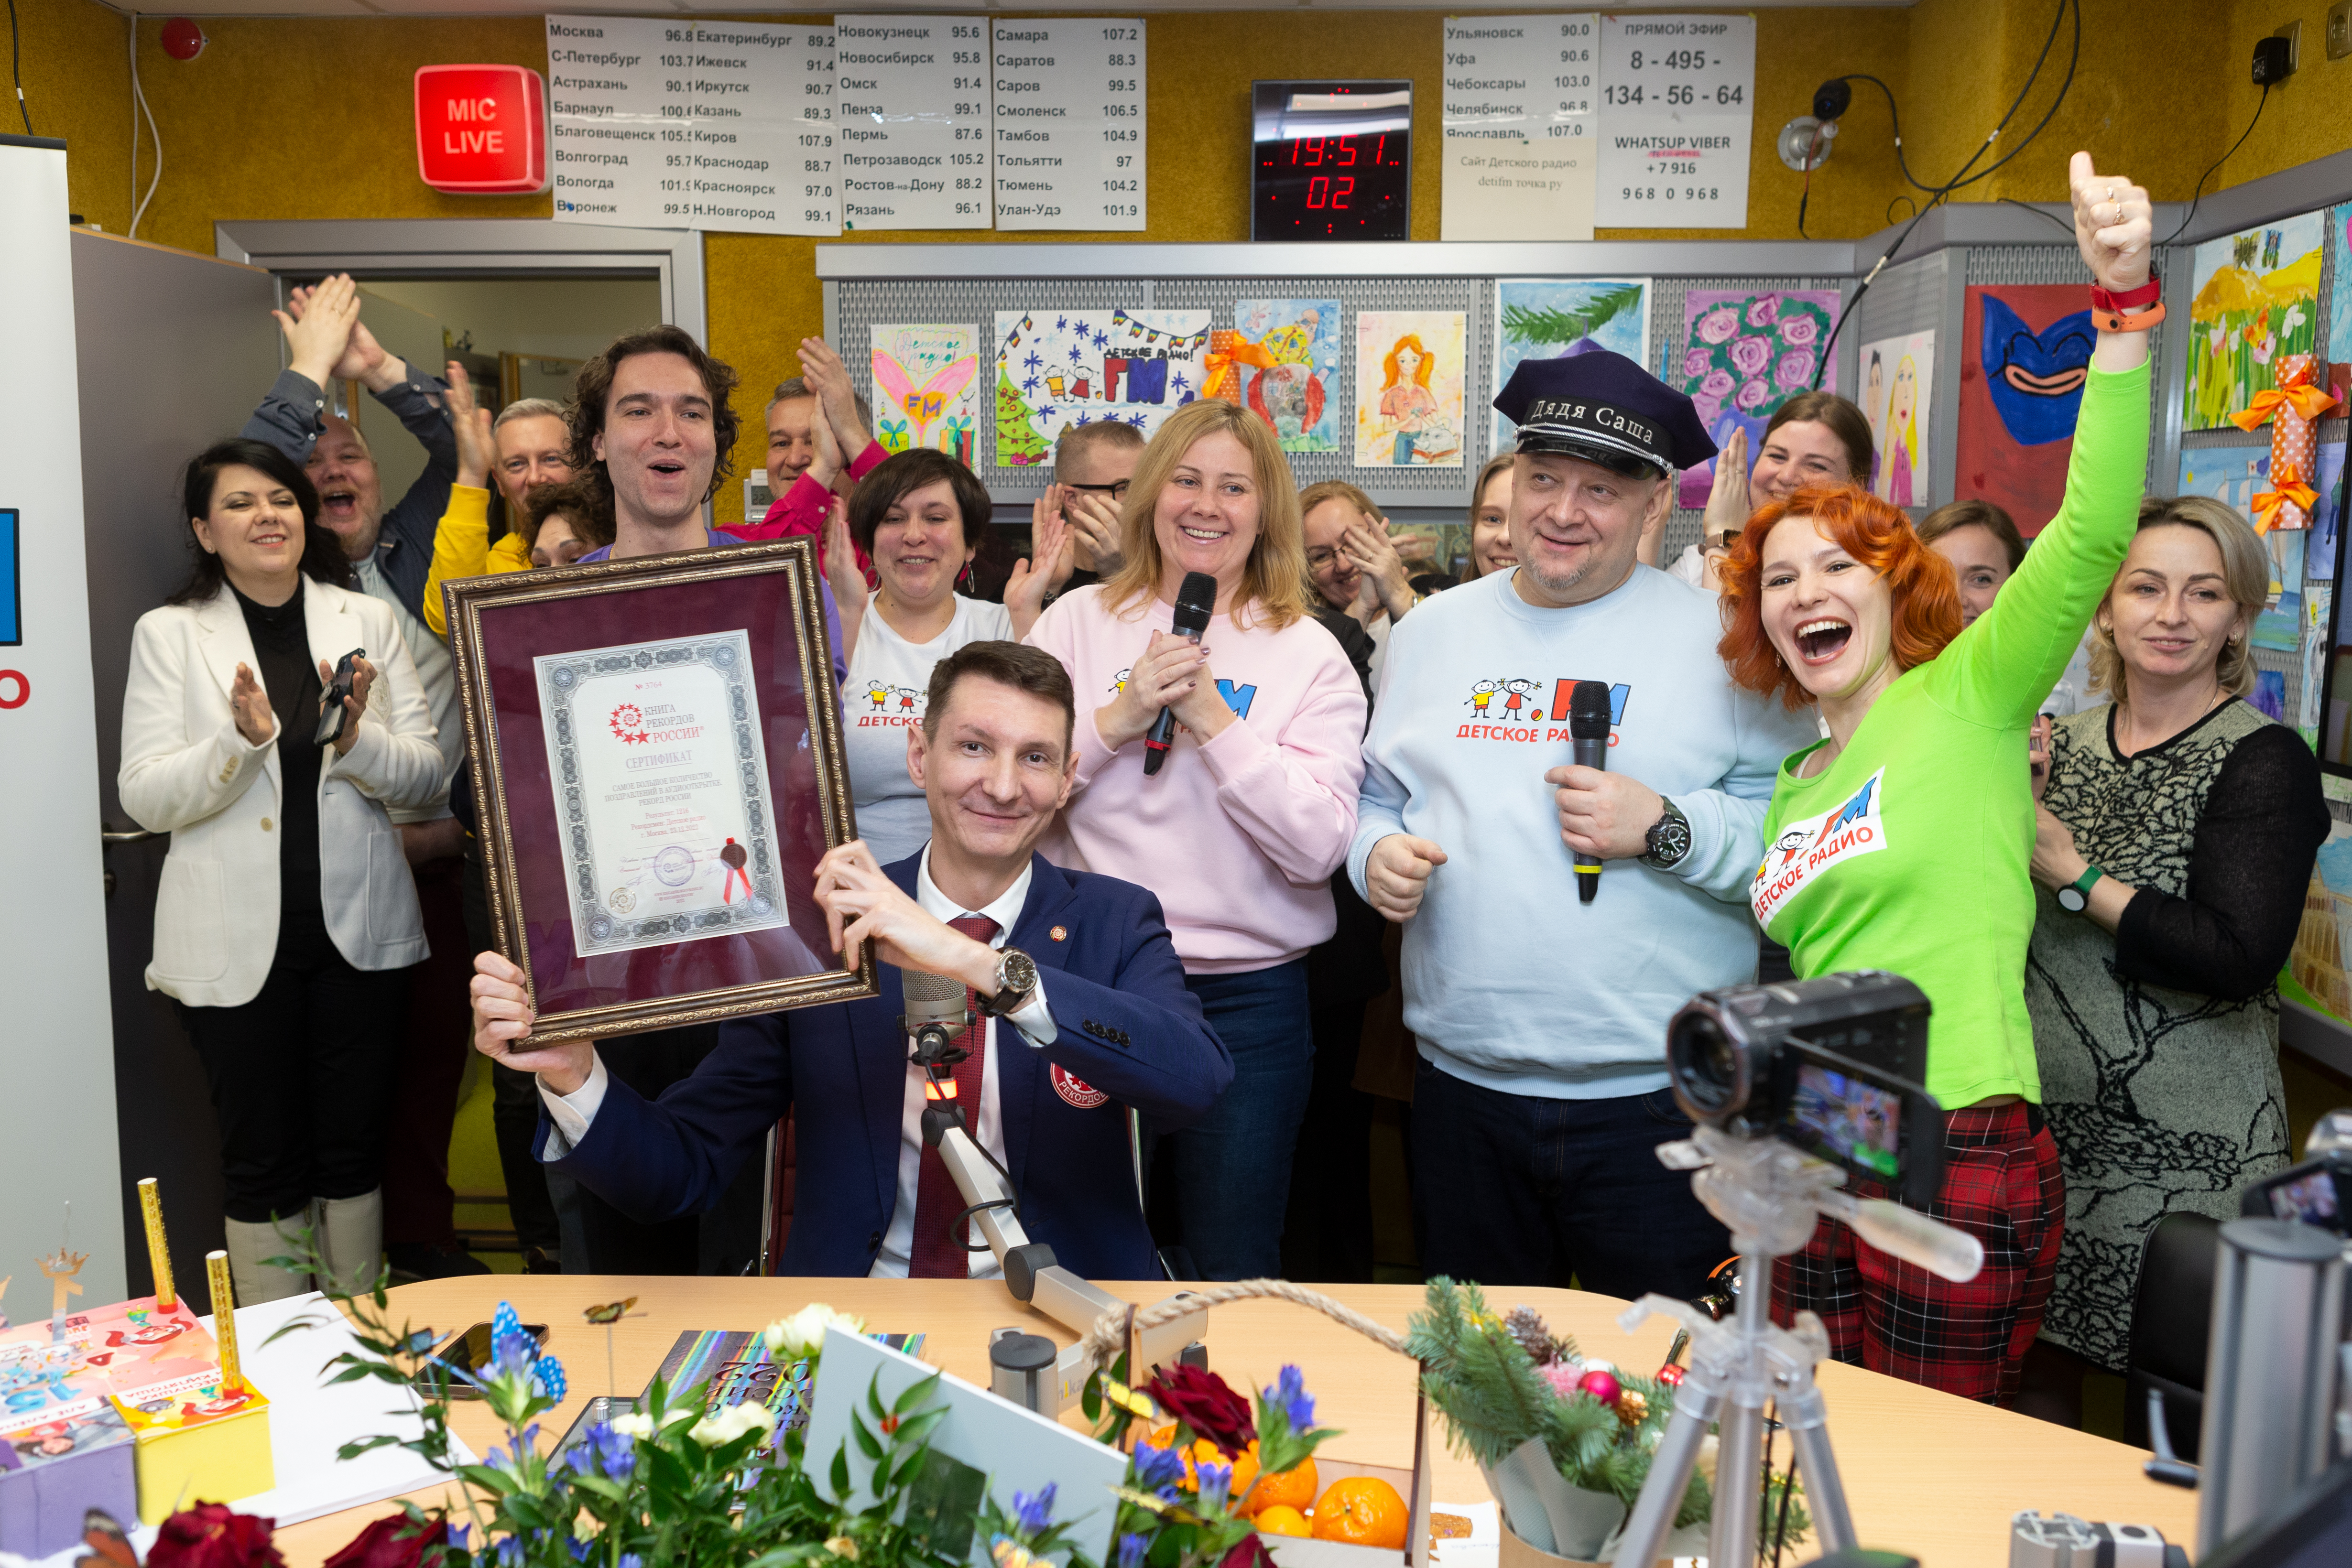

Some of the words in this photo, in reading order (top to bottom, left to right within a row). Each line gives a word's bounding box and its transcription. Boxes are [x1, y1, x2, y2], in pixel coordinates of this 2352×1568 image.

[550, 24, 604, 38] Москва
[665, 29, 693, 42] 96.8
[838, 25, 929, 41] Новокузнецк
[952, 26, 980, 38] 95.6
[996, 29, 1048, 43] Самара
[1102, 28, 1137, 40] 107.2
[1447, 27, 1523, 39] Ульяновск
[1561, 23, 1590, 37] 90.0
[1625, 23, 1685, 35] ПРЯМОЙ
[1689, 24, 1728, 35] ЭФИР
[697, 30, 792, 48] Екатеринбург
[808, 35, 835, 48] 89.2
[551, 49, 641, 67] С-Петербург
[660, 54, 694, 67] 103.7
[696, 55, 747, 68] Ижевск
[807, 59, 834, 71] 91.4
[839, 51, 934, 65] Новосибирск
[953, 52, 980, 64] 95.8
[996, 54, 1055, 69] Саратов
[1108, 54, 1136, 66] 88.3
[1447, 53, 1476, 67] Уфа
[1560, 49, 1589, 62] 90.6
[1631, 50, 1643, 70] 8
[1665, 50, 1705, 69] 495
[553, 75, 628, 90] Астрахань
[665, 80, 692, 92] 90.1
[695, 80, 749, 95] Иркутск
[805, 83, 833, 95] 90.7
[840, 77, 877, 89] Омск
[954, 77, 981, 89] 91.4
[996, 79, 1040, 94] Саров
[1108, 79, 1136, 91] 99.5
[1447, 78, 1525, 91] Чебоксары
[1554, 75, 1590, 88] 103.0
[1605, 85, 1644, 105] 134
[1667, 85, 1693, 105] 56
[1717, 85, 1743, 105] 64
[448, 99, 496, 121] MIC
[554, 100, 613, 117] Барнаул
[695, 104, 741, 117] Казань
[804, 108, 831, 119] 89.3
[841, 103, 883, 115] Пенза
[954, 103, 980, 115] 99.1
[996, 104, 1066, 117] Смоленск
[1103, 105, 1138, 117] 106.5
[1446, 103, 1523, 115] Челябинск
[555, 124, 655, 141] Благовещенск
[842, 128, 888, 142] Пермь
[955, 128, 982, 140] 87.6
[997, 129, 1049, 141] Тамбов
[1103, 130, 1137, 141] 104.9
[1547, 124, 1582, 137] 107.0
[445, 131, 504, 154] LIVE
[695, 130, 737, 144] Киров
[798, 135, 832, 147] 107.9
[1615, 137, 1686, 149] WHATSUP
[1689, 137, 1730, 149] VIBER
[1292, 134, 1385, 166] 19:51
[555, 150, 628, 166] Волгоград
[666, 155, 691, 166] 95.7
[694, 155, 769, 172] Краснодар
[805, 160, 831, 172] 88.7
[843, 153, 942, 168] Петрозаводск
[950, 153, 984, 165] 105.2
[997, 154, 1062, 166] Тольятти
[1116, 156, 1132, 167] 97
[1461, 157, 1485, 166] Сайт
[1489, 158, 1538, 168] Детского
[1542, 160, 1577, 169] радио
[1659, 162, 1667, 174] 7
[1671, 162, 1696, 174] 916
[556, 174, 614, 189] Вологда
[694, 179, 775, 196] Красноярск
[806, 185, 832, 197] 97.0
[956, 178, 982, 189] 88.2
[997, 179, 1053, 191] Тюмень
[1103, 180, 1137, 191] 104.2
[1478, 176, 1512, 187] detifm
[1550, 181, 1562, 191] ру
[1307, 177, 1355, 209] 02
[1622, 187, 1655, 200] 968
[1666, 187, 1675, 200] 0
[1686, 188, 1718, 200] 968
[664, 204, 689, 214] 99.5
[693, 204, 775, 221] Н.Новгород
[805, 210, 830, 222] 99.1
[846, 204, 894, 215] Рязань
[955, 202, 980, 214] 96.1
[998, 204, 1061, 216] Улан-Удэ
[899, 333, 960, 351] Детское
[1104, 357, 1169, 405] FM
[908, 395, 942, 418] FM
[1531, 400, 1586, 422] Дядя
[1596, 407, 1654, 445] Саша
[1212, 679, 1258, 721] M
[644, 704, 676, 716] КНИГА
[646, 714, 695, 728] РЕКОРДОВ
[857, 716, 924, 727] ДЕТСКО
[1456, 725, 1539, 742] ДЕТСКОЕ
[1546, 728, 1620, 747] РАО
[626, 750, 692, 768] СЕРТИФИКАТ
[612, 783, 635, 792] САМОЕ
[636, 778, 668, 788] БОЛЬШОЕ
[670, 772, 712, 783] КОЛИЧЕСТВО
[605, 788, 657, 802] ПОЗДРАВЛЕНИЙ
[639, 797, 664, 806] РЕКОРД
[665, 793, 691, 802] РОССИИ
[1754, 864, 1804, 920] ДЕТСКОЕ
[1809, 827, 1873, 870] РАДИО
[715, 1361, 810, 1383] 022
[703, 1386, 814, 1399] ОССИИ
